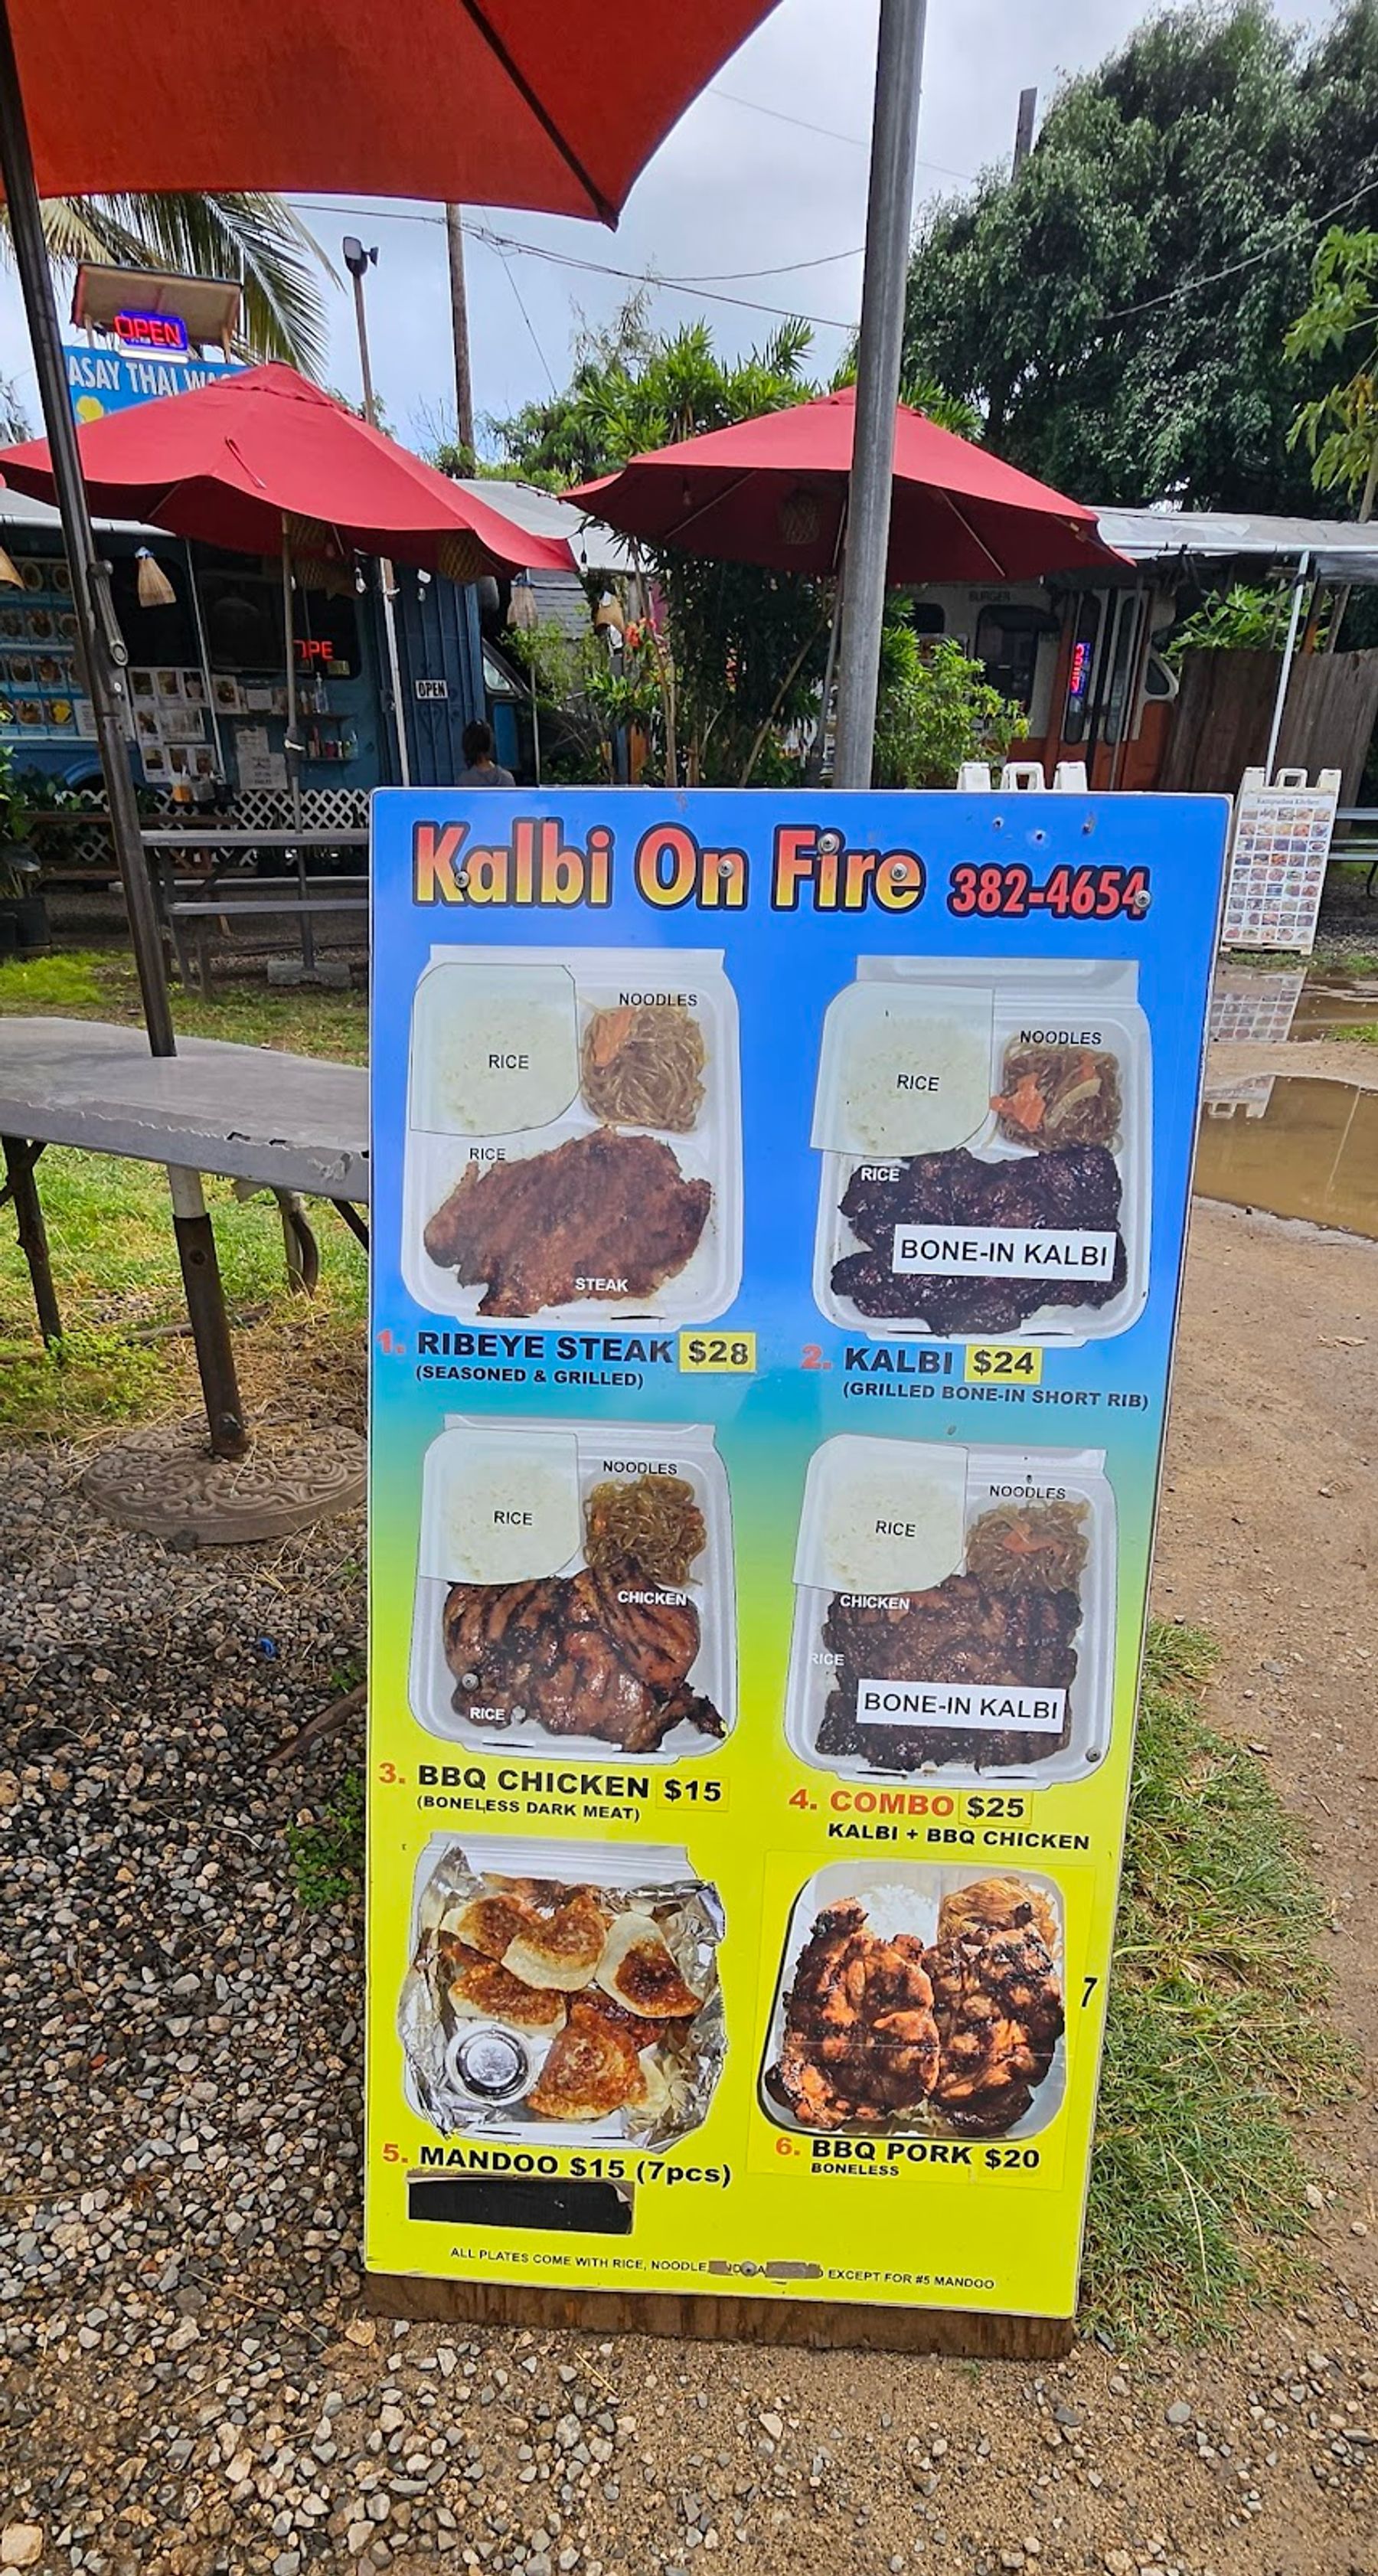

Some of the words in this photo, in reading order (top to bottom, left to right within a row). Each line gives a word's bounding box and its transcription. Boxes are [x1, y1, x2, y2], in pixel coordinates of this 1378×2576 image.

[114, 315, 181, 345] OPEN
[126, 361, 180, 397] THAI
[418, 682, 446, 698] OPEN
[413, 816, 615, 908] Kalbi
[635, 821, 748, 911] On
[772, 824, 926, 913] Fire
[948, 862, 1150, 920] 382-4654
[619, 993, 697, 1006] NOODLES
[1020, 1031, 1102, 1044] NOODLES
[488, 1054, 529, 1069] RICE
[896, 1074, 939, 1091] RICE
[469, 1148, 505, 1160] RICE
[860, 1168, 900, 1182] RICE
[900, 1239, 1014, 1263] BONE-IN
[1024, 1244, 1107, 1266] KALBI
[575, 1277, 628, 1292] STEAK
[377, 1330, 405, 1353] 1.
[418, 1332, 544, 1359] RIBEYE
[557, 1337, 674, 1363] STEAK
[688, 1339, 748, 1365] $28
[801, 1345, 832, 1369] 2.
[845, 1348, 952, 1374] KALBI
[973, 1350, 1034, 1375] $24
[416, 1365, 526, 1381] (SEASONED
[534, 1371, 546, 1382] &
[554, 1370, 643, 1390] GRILLED)
[844, 1382, 934, 1399] (GRILLED
[942, 1388, 1024, 1404] BONE-IN
[1032, 1391, 1101, 1406] SHORT
[1108, 1395, 1148, 1410] RIB)
[603, 1460, 678, 1475] NOODLES
[990, 1486, 1065, 1500] NOODLES
[494, 1511, 532, 1525] RICE
[876, 1520, 916, 1537] RICE
[618, 1590, 687, 1606] CHICKEN
[841, 1595, 909, 1610] CHICKEN
[811, 1653, 844, 1666] RICE
[470, 1708, 505, 1721] RICE
[864, 1693, 971, 1715] BONE-IN
[980, 1699, 1057, 1719] KALBI
[379, 1762, 406, 1784] 3.
[419, 1765, 485, 1790] BBQ
[498, 1770, 649, 1798] CHICKEN
[665, 1779, 722, 1802] $15
[417, 1796, 519, 1813] (BONELESS
[527, 1802, 576, 1816] DARK
[583, 1806, 640, 1822] MEAT)
[789, 1789, 818, 1810] 4.
[830, 1791, 954, 1816] COMBO
[967, 1796, 1024, 1819] $25
[828, 1822, 898, 1840] KALBI
[906, 1829, 918, 1839] +
[926, 1828, 975, 1844] BBQ
[983, 1831, 1089, 1850] CHICKEN
[1081, 1977, 1097, 2008] 7
[775, 2137, 801, 2156] 6.
[811, 2140, 876, 2160] BBQ
[887, 2144, 972, 2165] PORK
[985, 2148, 1040, 2169] $20
[382, 2143, 409, 2163] 5.
[420, 2146, 558, 2175] MANDOO
[570, 2158, 625, 2178] $15
[636, 2161, 731, 2188] (7pcs)
[811, 2162, 900, 2176] BONELESS
[451, 2247, 475, 2258] ALL
[479, 2250, 529, 2263] PLATES
[533, 2254, 572, 2265] COME
[575, 2257, 609, 2268] WITH
[613, 2258, 647, 2270] RICE,
[651, 2260, 707, 2272] NOODLE
[828, 2269, 880, 2281] EXCEPT
[884, 2274, 913, 2283] FOR
[916, 2275, 930, 2284] #5
[934, 2277, 994, 2289] MANDOO
